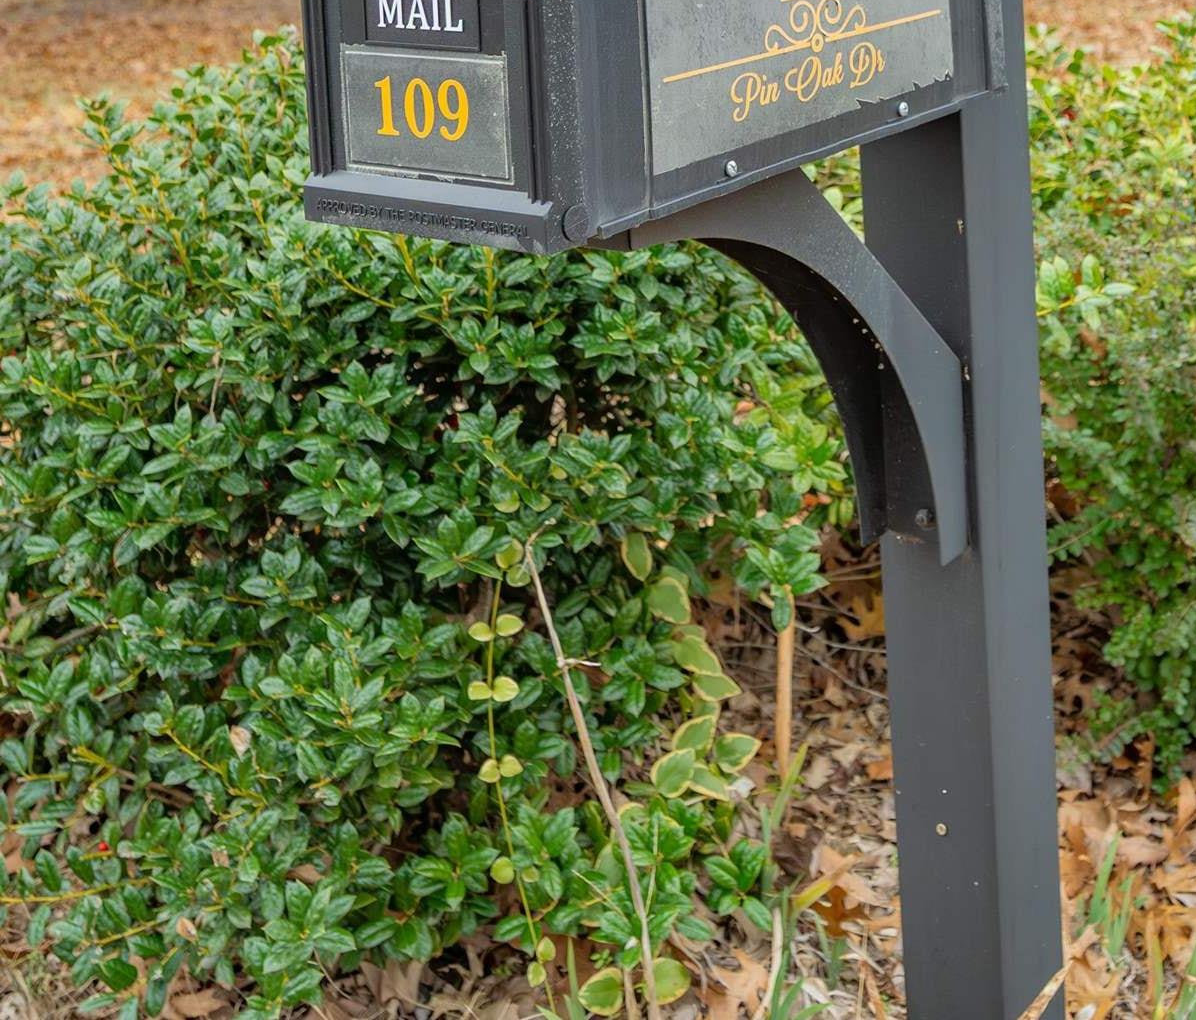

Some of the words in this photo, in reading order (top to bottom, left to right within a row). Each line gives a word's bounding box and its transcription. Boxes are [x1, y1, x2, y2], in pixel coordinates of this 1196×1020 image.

[374, 75, 469, 141] 109
[730, 72, 780, 122] Pin
[784, 52, 844, 103] Oak
[849, 41, 886, 89] Dr
[316, 198, 368, 217] APPROVED
[367, 204, 383, 218] BY
[384, 206, 406, 221] THE
[408, 209, 476, 231] POSTMASTER
[480, 219, 530, 239] GENERAL
